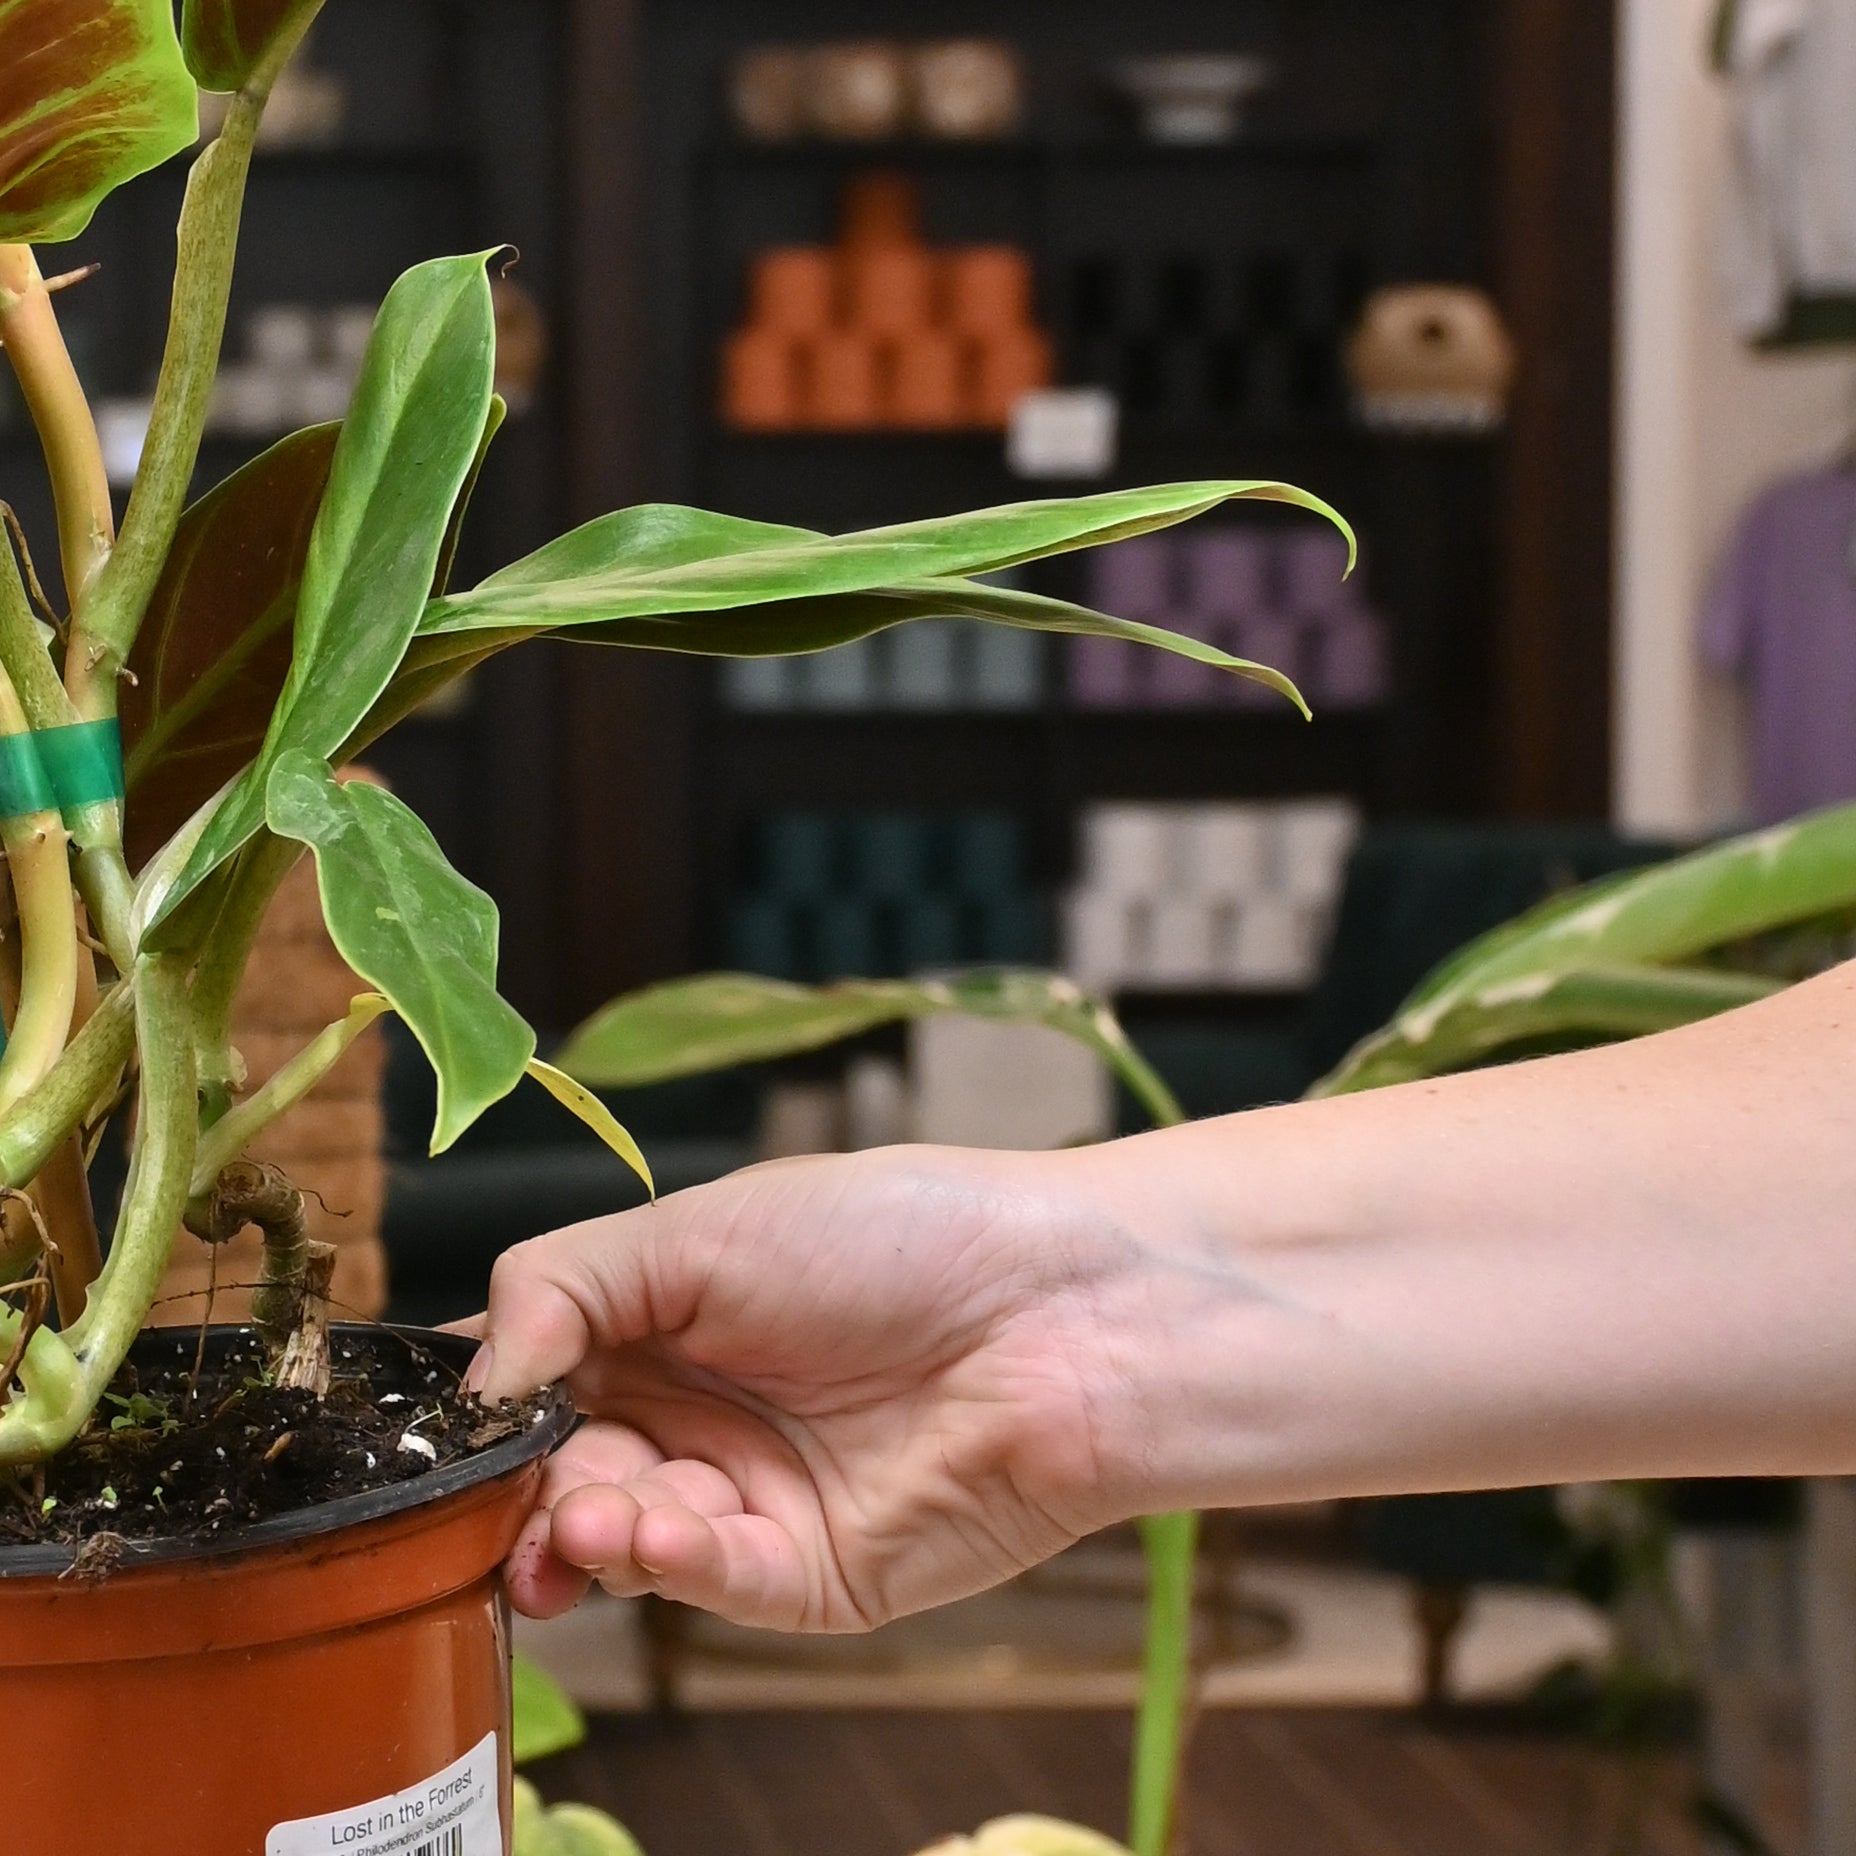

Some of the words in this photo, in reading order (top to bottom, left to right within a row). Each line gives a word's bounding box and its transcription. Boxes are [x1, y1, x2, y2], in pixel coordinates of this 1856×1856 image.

[332, 1817, 372, 1845] Lost
[379, 1811, 394, 1831] in
[399, 1801, 424, 1824] the
[429, 1767, 472, 1811] Forrest
